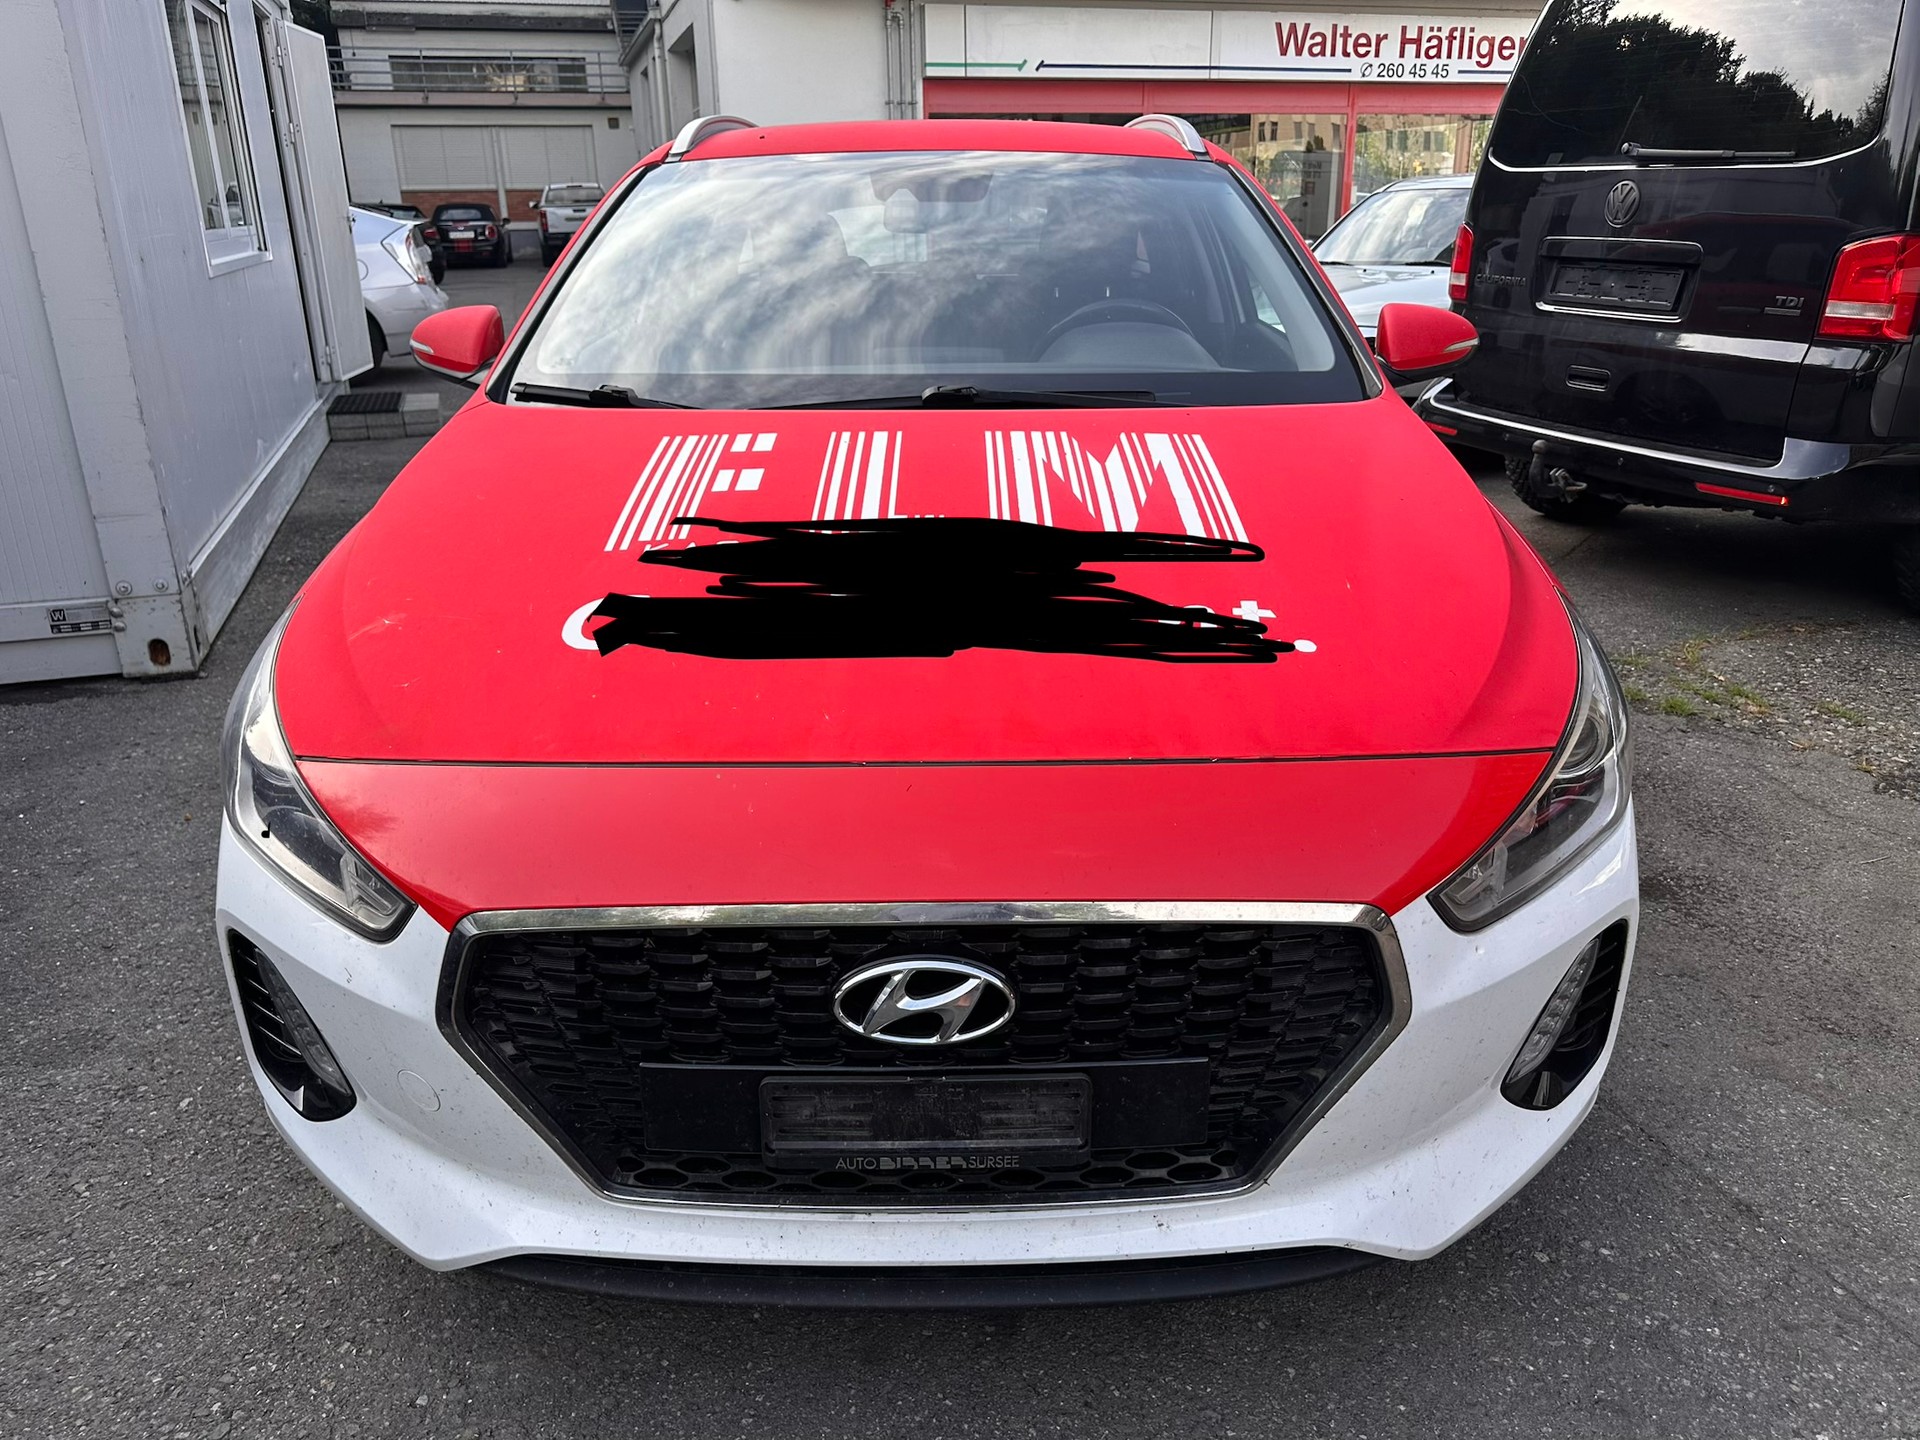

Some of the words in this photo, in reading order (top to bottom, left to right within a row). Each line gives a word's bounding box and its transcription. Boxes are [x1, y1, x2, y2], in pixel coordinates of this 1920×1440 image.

[1275, 22, 1388, 58] Walter
[1377, 63, 1405, 78] 260
[1409, 64, 1427, 78] 45
[1431, 64, 1449, 78] 45
[1775, 295, 1805, 308] TDI
[835, 1157, 877, 1170] AUTO
[968, 1155, 1020, 1169] SURSEE
